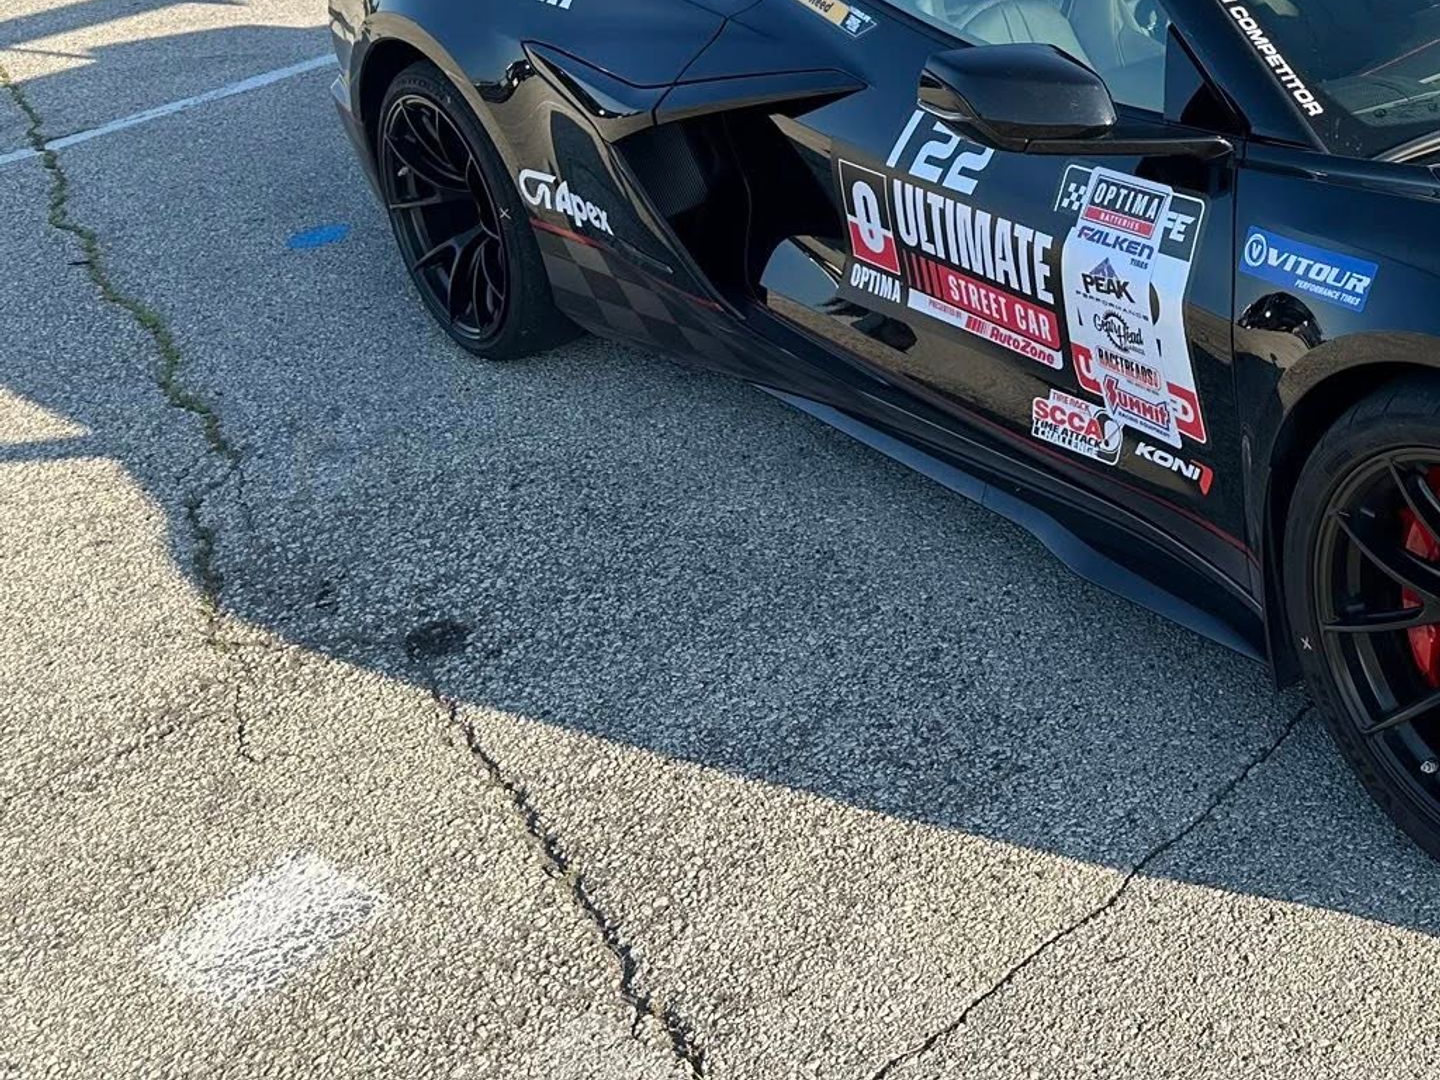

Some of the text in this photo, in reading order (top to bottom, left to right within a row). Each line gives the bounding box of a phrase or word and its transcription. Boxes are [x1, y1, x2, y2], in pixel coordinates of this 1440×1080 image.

[1230, 5, 1324, 116] COMPETITOR
[556, 180, 614, 236] Apex
[1094, 182, 1160, 221] OPTIMA
[1100, 211, 1140, 231] BATTERIES
[893, 178, 1055, 305] ULTIMATE
[1077, 226, 1155, 260] FALKEN
[850, 262, 901, 304] OPTIMA
[1081, 273, 1135, 303] PEAK
[1267, 248, 1370, 294] VITOUR
[948, 274, 1052, 343] STREET CAR
[1294, 279, 1361, 306] PERFORMANCE TIRES
[990, 326, 1055, 365] AutoZone
[1034, 400, 1103, 440] SCCA
[1034, 417, 1102, 449] TIME ATTACK
[1135, 442, 1201, 480] KONI
